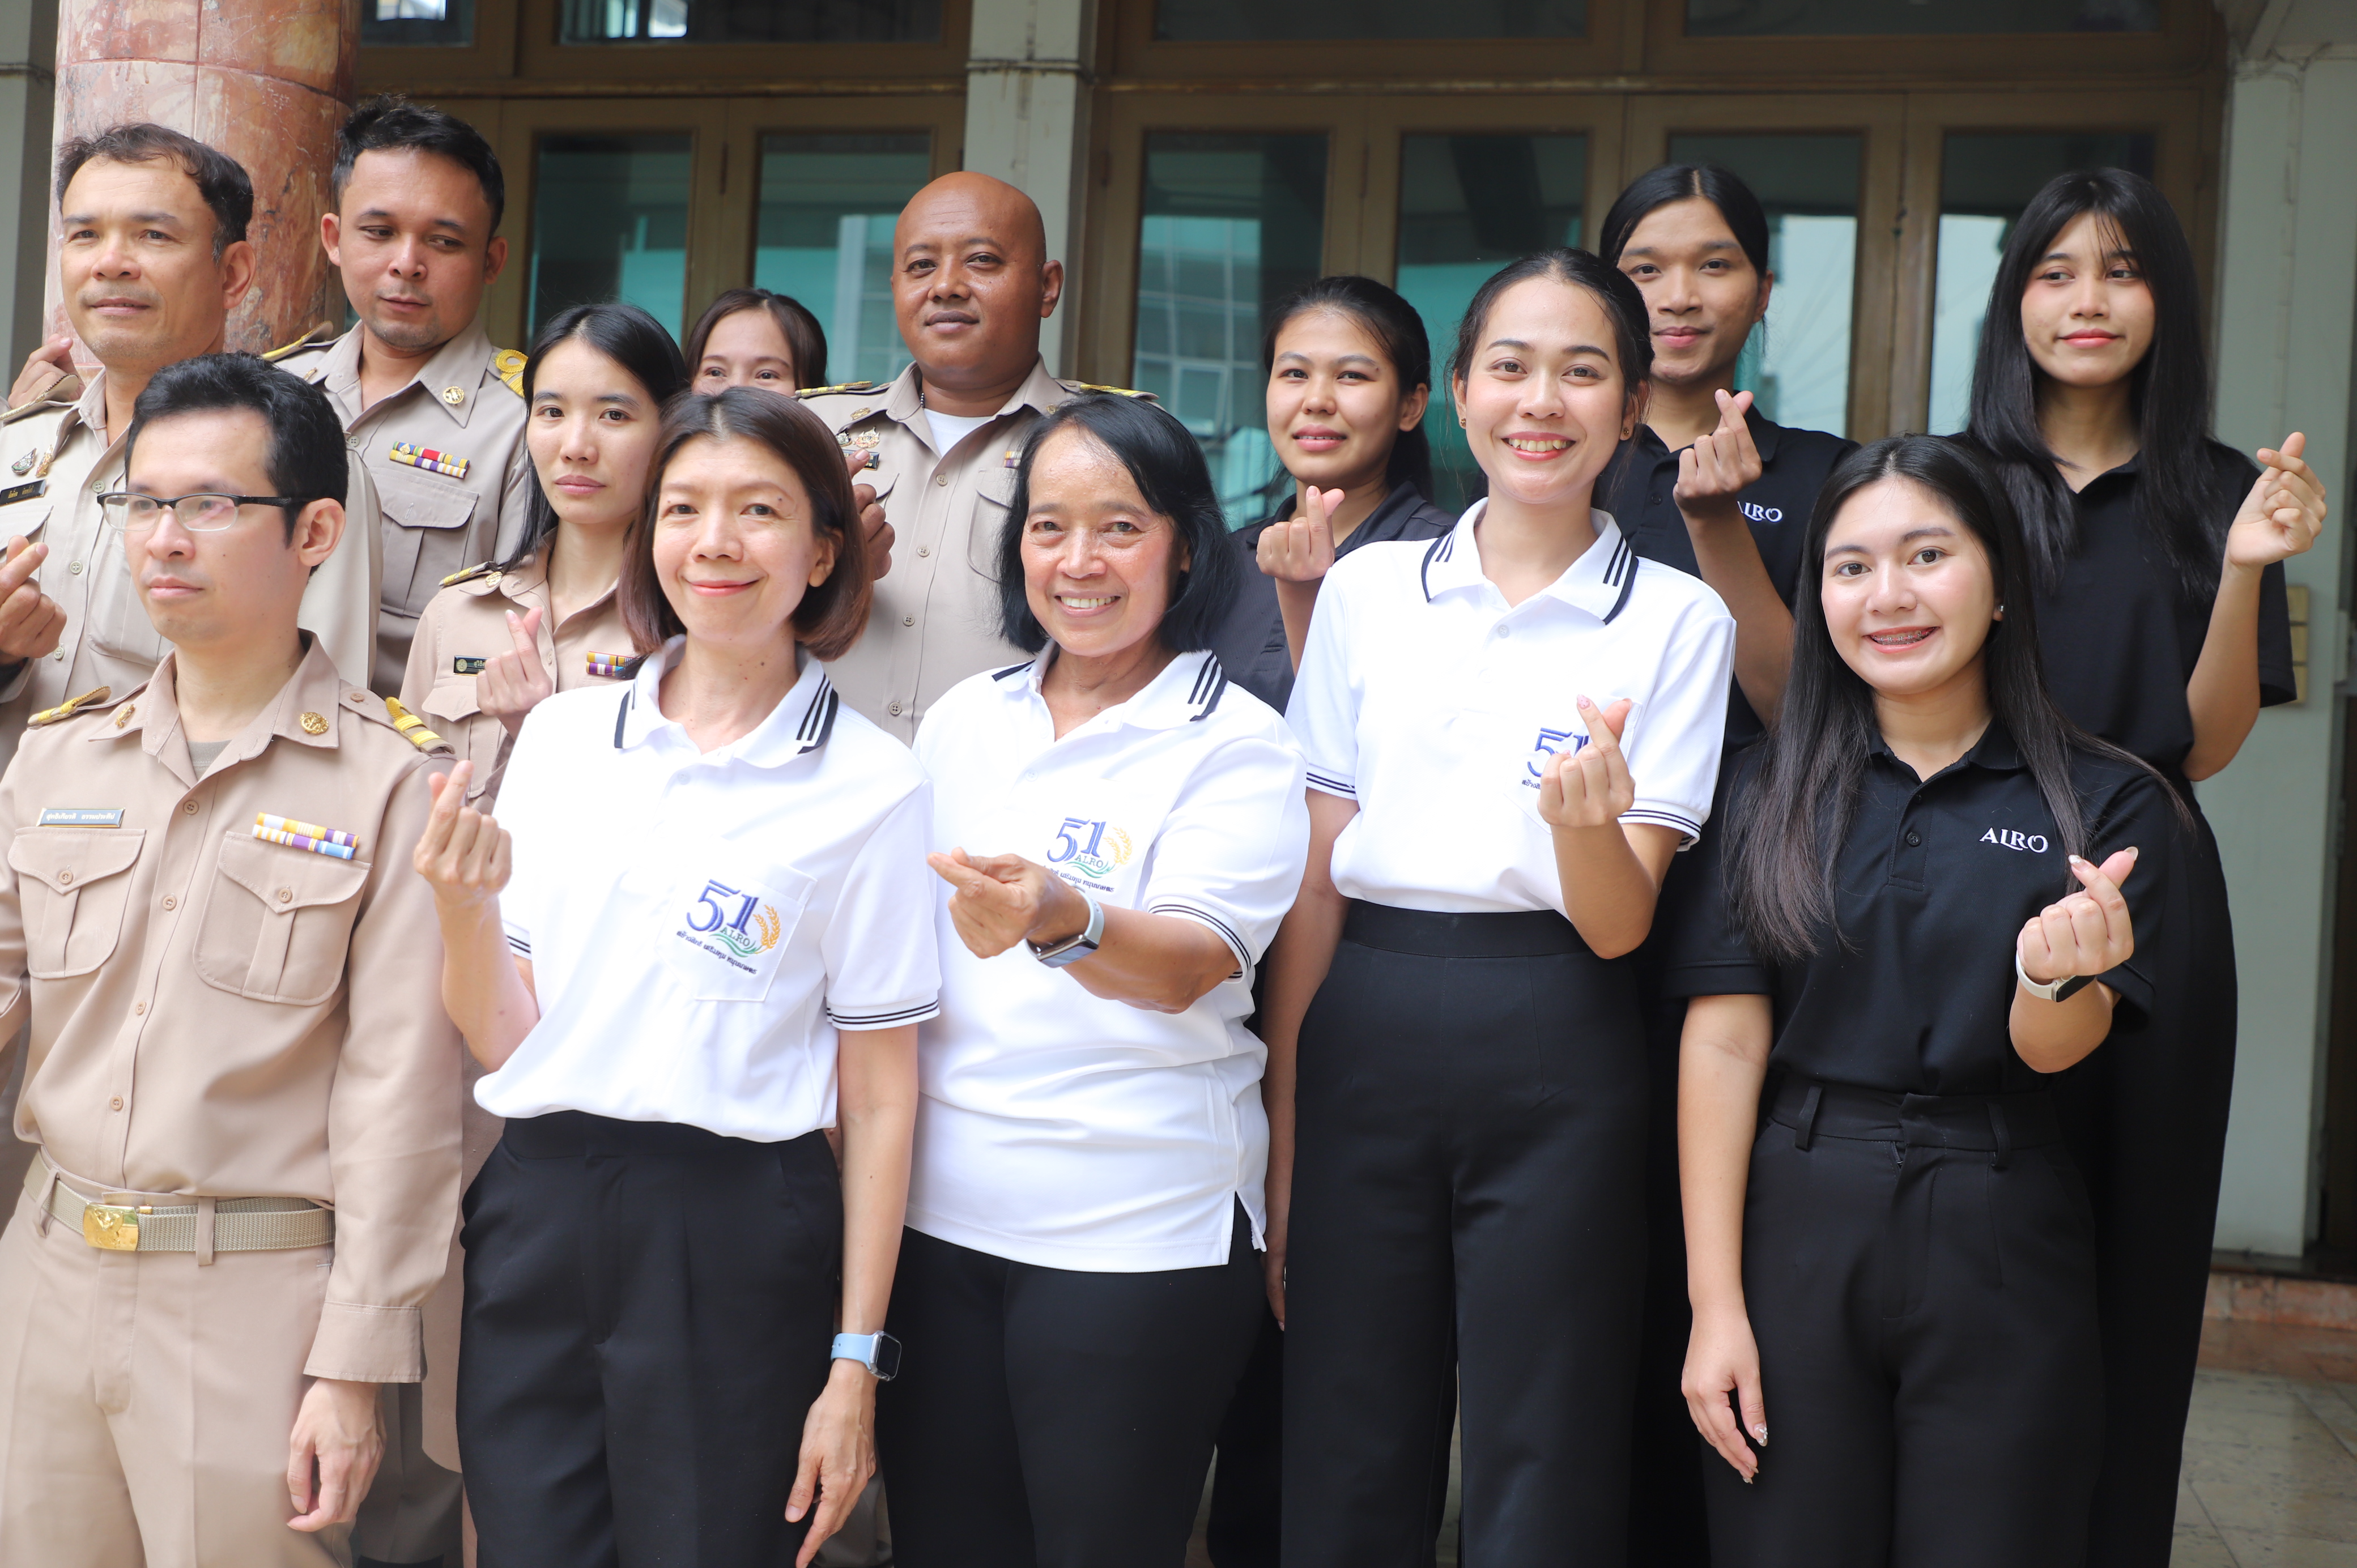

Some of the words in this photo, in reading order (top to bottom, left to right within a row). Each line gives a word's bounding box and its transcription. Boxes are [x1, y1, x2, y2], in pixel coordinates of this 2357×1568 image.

[1737, 501, 1783, 522] LRO
[1047, 817, 1107, 862] 51
[1979, 827, 2049, 853] ALRO
[1074, 854, 1104, 868] ALRO
[686, 879, 759, 936] 51
[720, 926, 751, 947] ALRO
